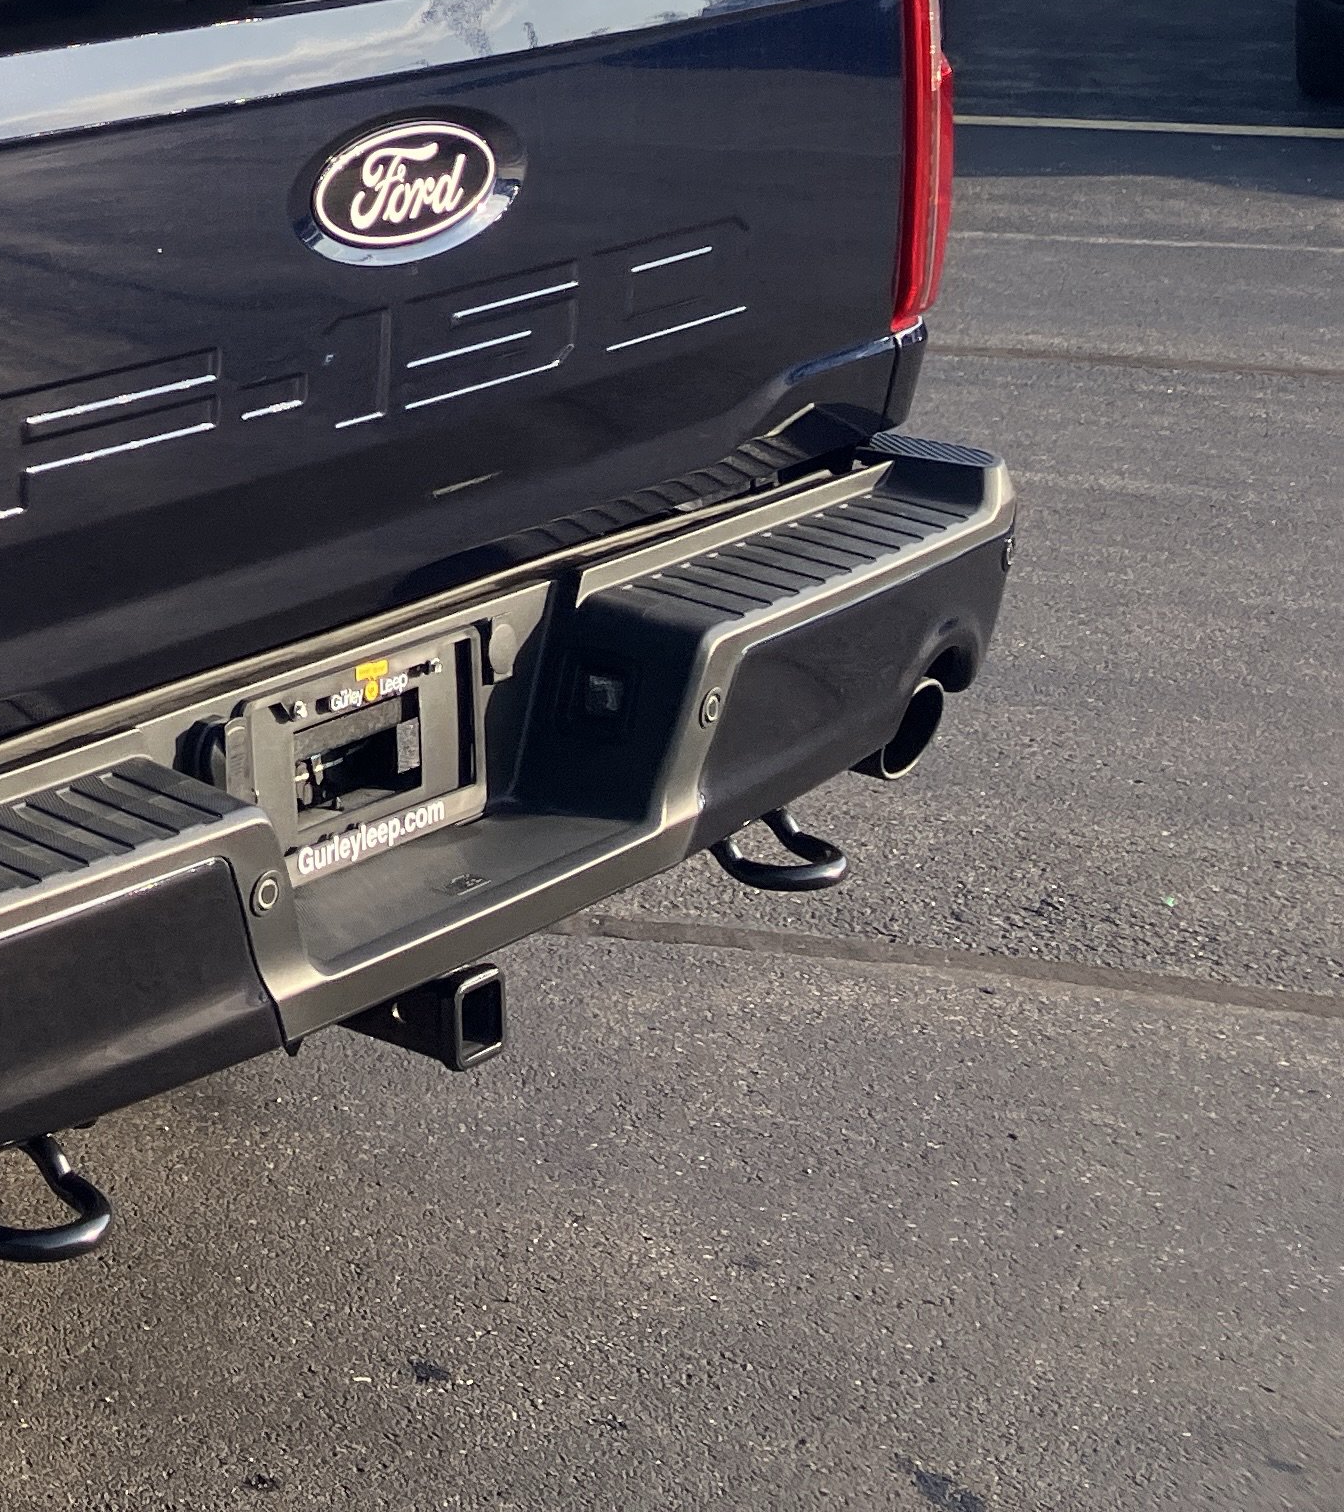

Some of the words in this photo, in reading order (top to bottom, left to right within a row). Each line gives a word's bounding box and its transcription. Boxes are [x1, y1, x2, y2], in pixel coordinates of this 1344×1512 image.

[350, 142, 467, 230] Ford
[379, 673, 408, 694] Leep
[298, 800, 445, 875] Gurleyleep.com
